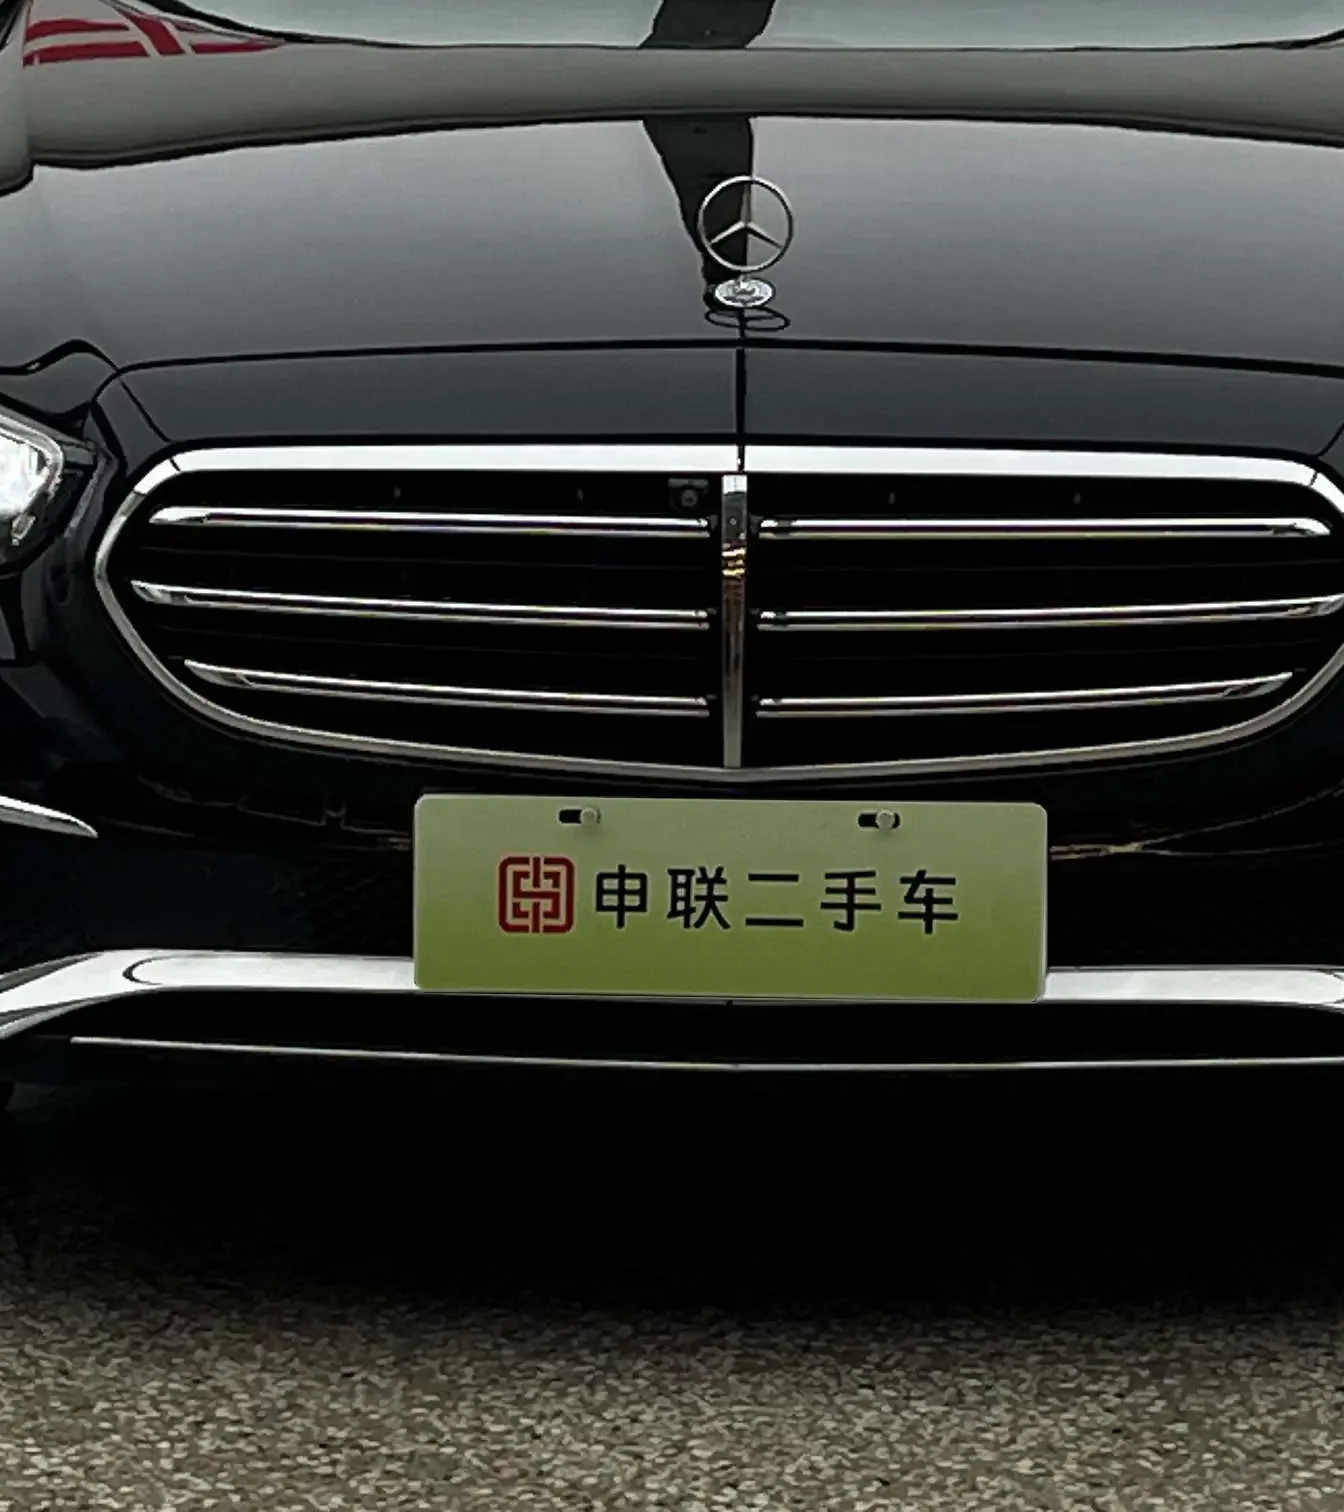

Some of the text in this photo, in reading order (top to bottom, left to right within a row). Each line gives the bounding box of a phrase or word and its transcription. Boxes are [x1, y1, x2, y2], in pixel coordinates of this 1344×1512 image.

[594, 864, 960, 935] 申联二手车
